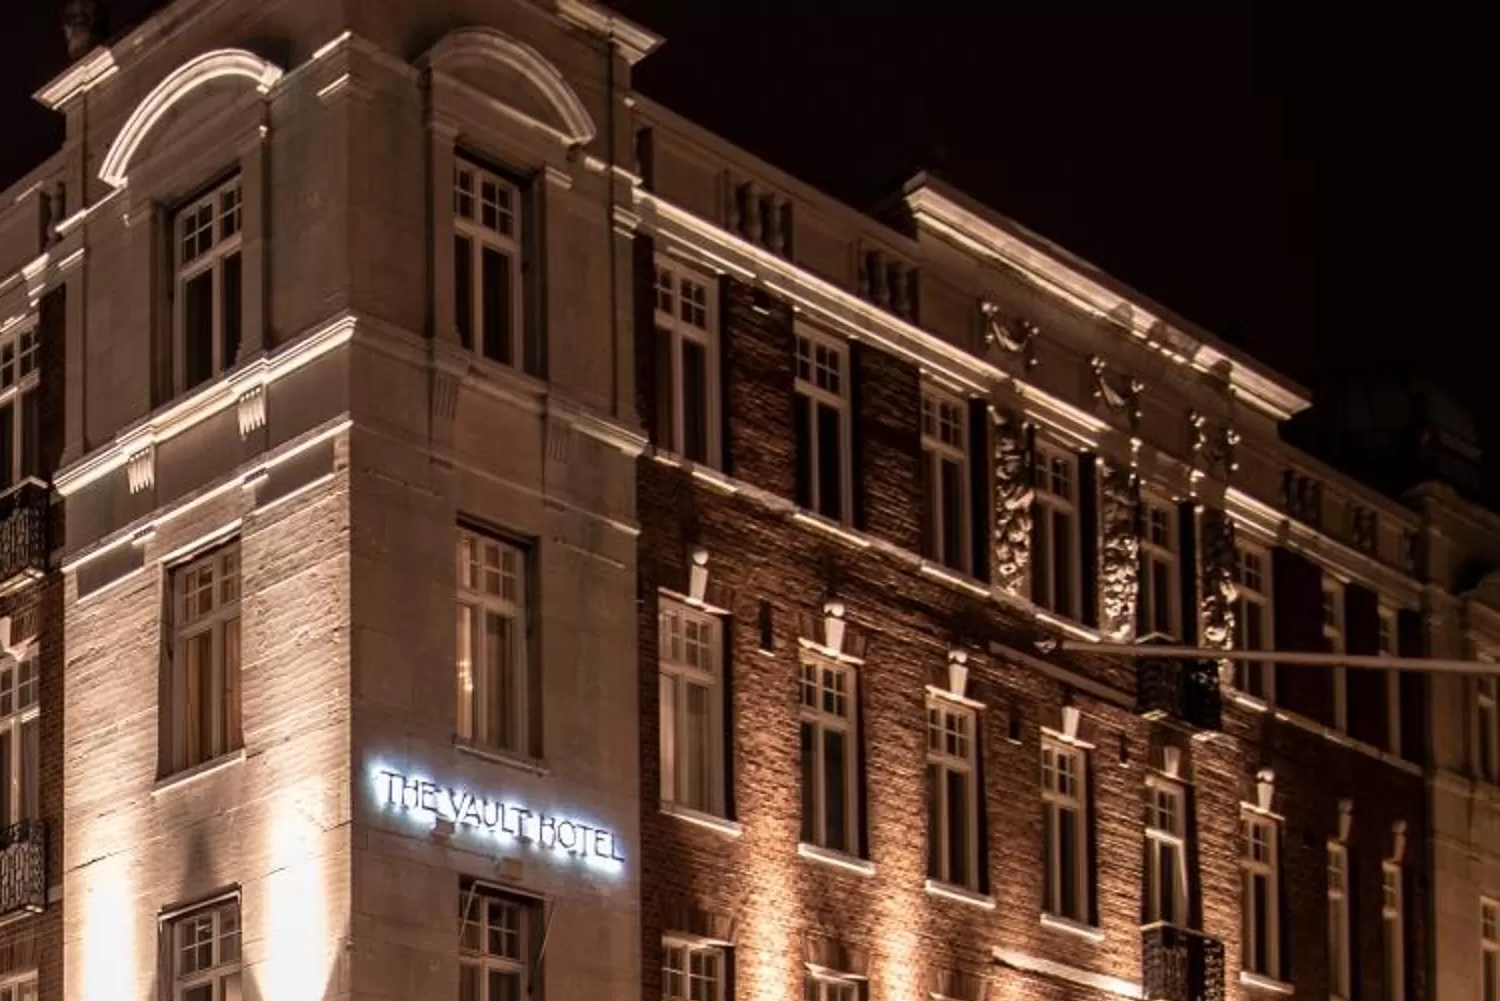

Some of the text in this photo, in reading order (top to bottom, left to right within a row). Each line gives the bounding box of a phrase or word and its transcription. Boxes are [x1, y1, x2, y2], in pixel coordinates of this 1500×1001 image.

[381, 770, 625, 863] THE VAULT HOTEL
